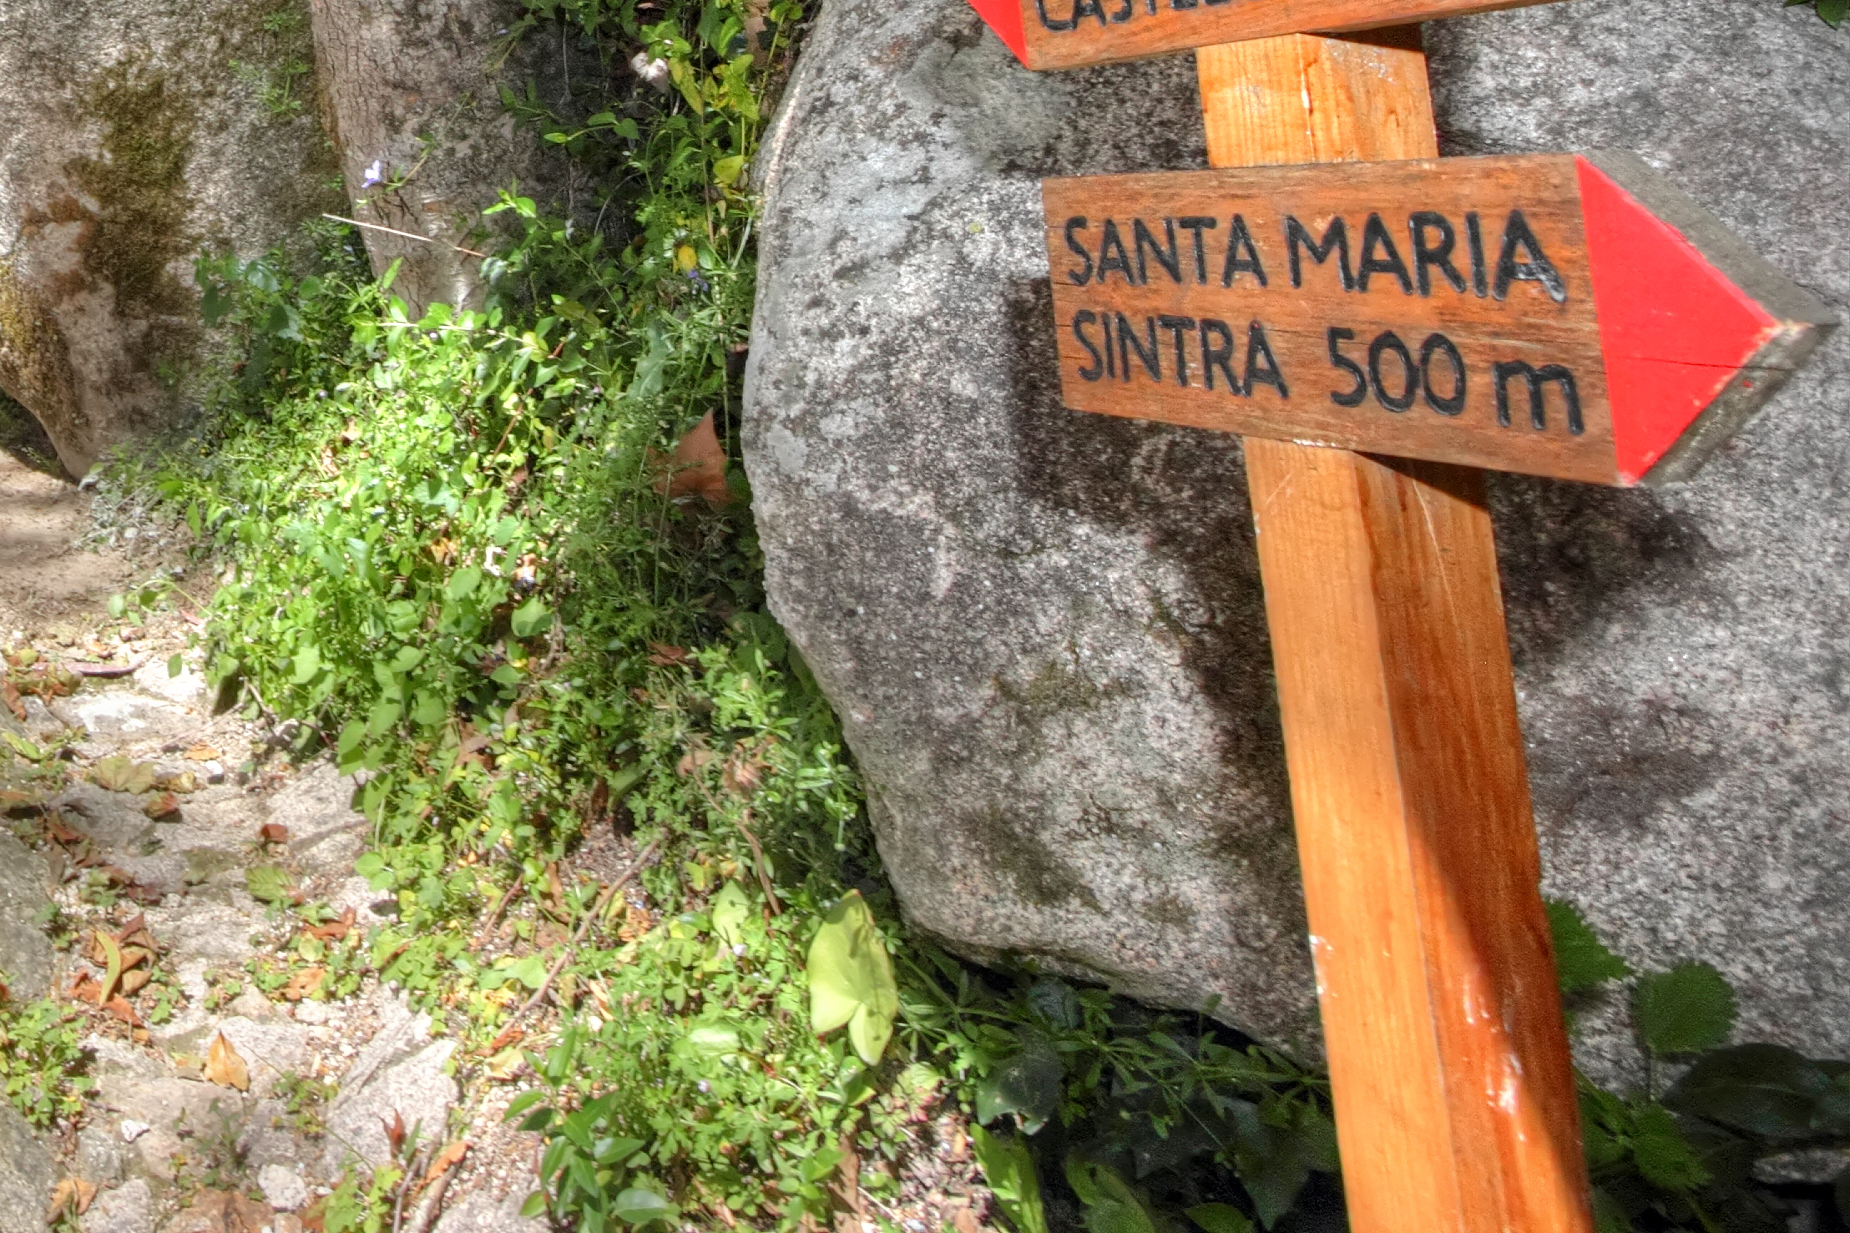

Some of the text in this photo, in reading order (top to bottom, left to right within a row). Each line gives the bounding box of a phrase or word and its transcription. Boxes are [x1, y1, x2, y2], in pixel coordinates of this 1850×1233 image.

[1063, 209, 1568, 303] SANTA MARIA
[1072, 309, 1289, 399] SINTRA
[1327, 326, 1467, 416] 500
